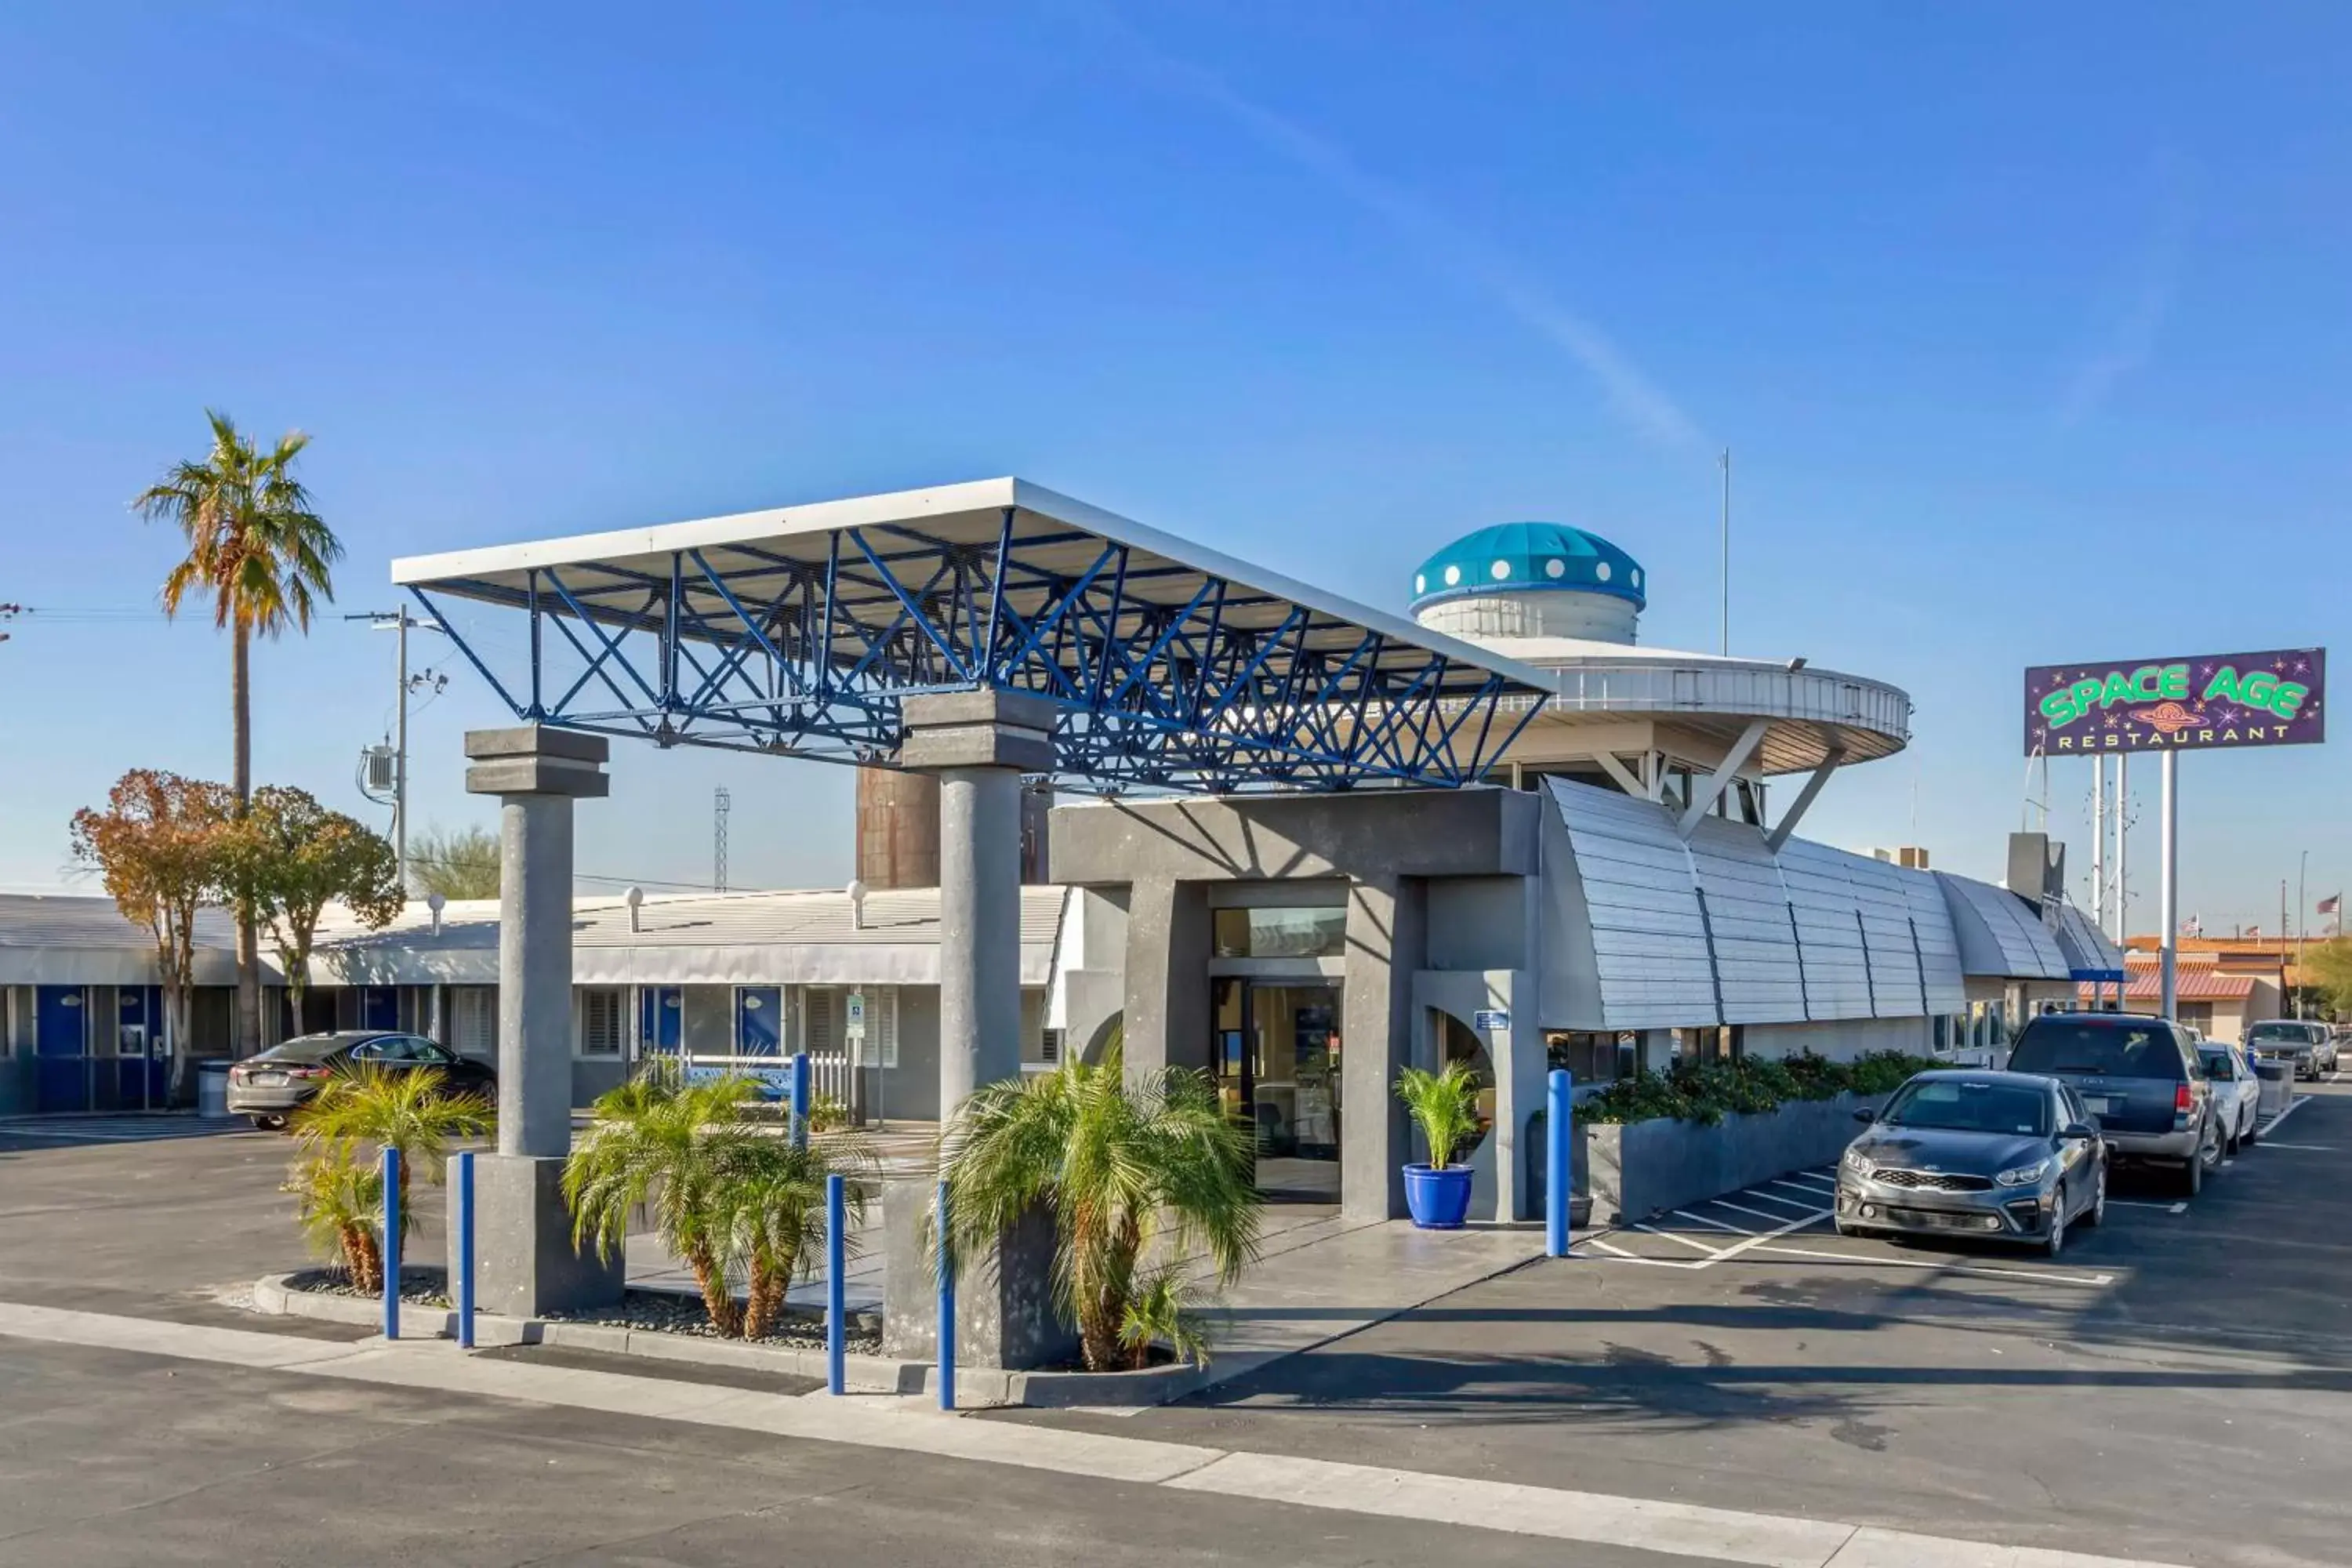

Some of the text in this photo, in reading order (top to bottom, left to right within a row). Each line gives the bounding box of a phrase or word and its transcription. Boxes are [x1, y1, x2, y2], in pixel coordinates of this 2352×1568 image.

[2039, 664, 2309, 729] SPACE AGE
[2058, 725, 2288, 749] RESTAURANT
